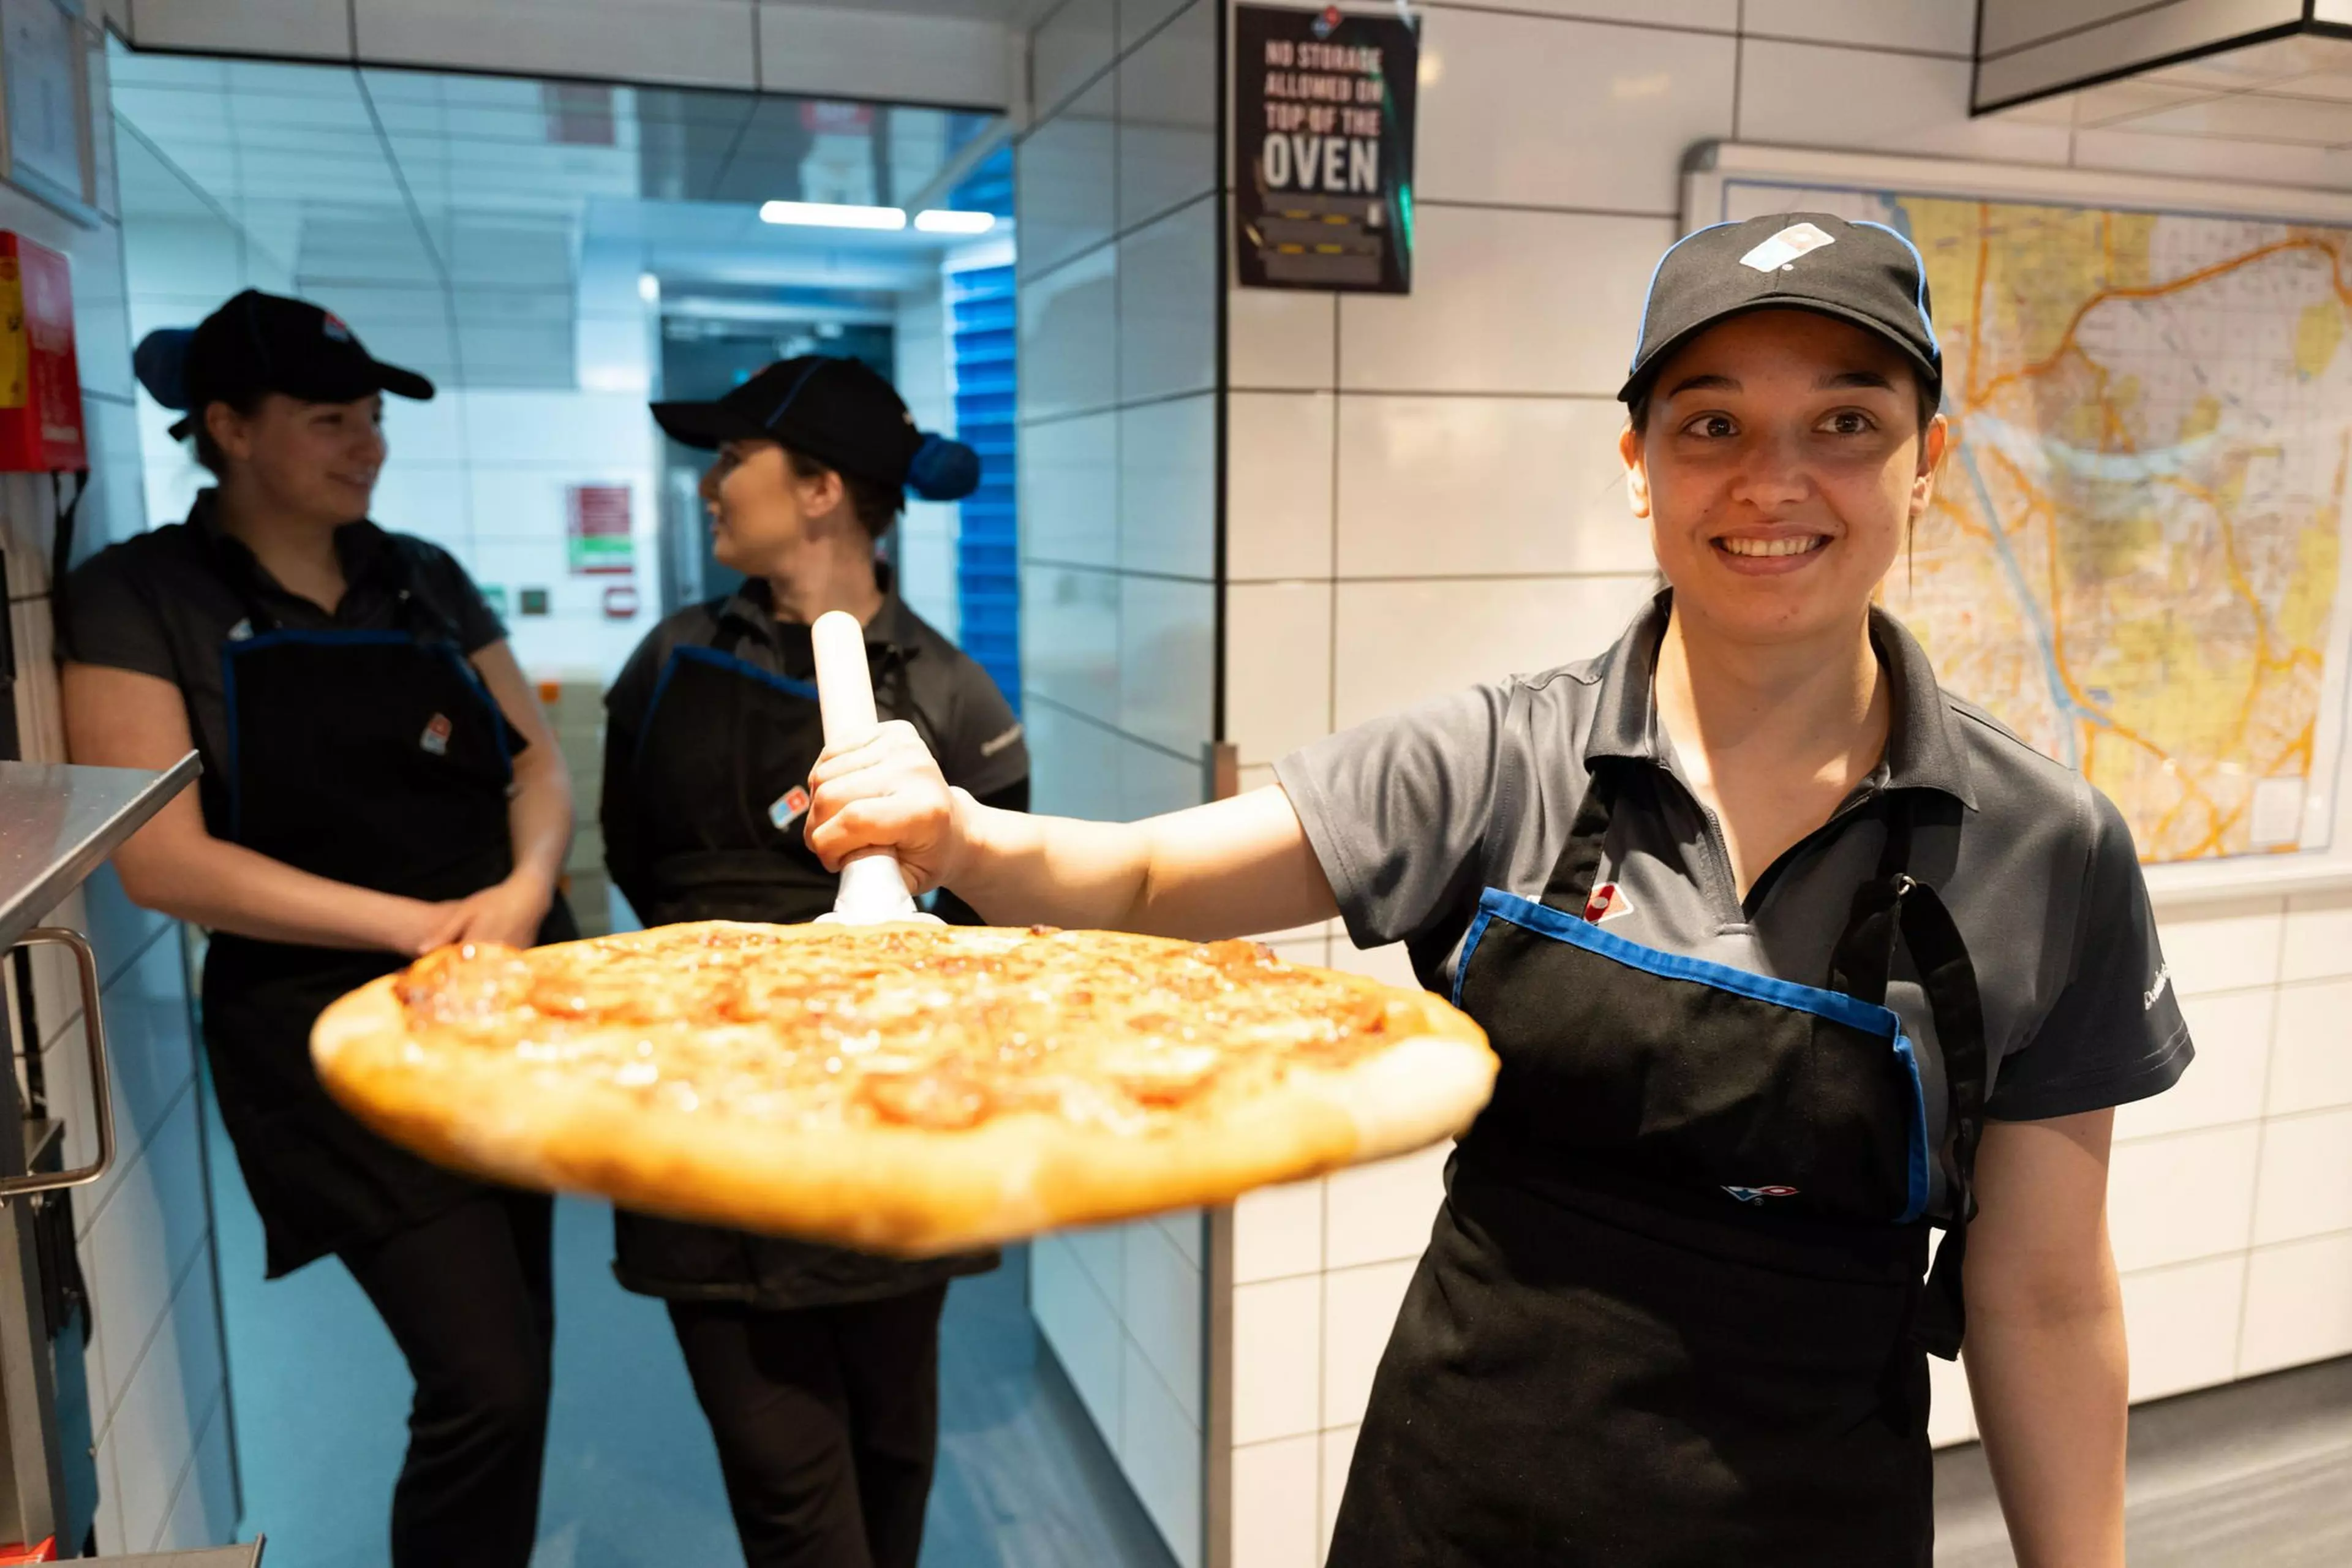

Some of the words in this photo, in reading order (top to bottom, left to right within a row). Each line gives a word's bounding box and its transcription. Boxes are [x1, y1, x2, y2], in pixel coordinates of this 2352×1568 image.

[1265, 40, 1294, 67] NO
[1297, 43, 1382, 72] STORAGE
[1264, 72, 1352, 102] ALLOWED
[1355, 80, 1384, 104] ON
[1265, 103, 1305, 131] TOP
[1309, 107, 1338, 134] OF
[1341, 108, 1381, 136] THE
[1264, 134, 1379, 193] OVEN
